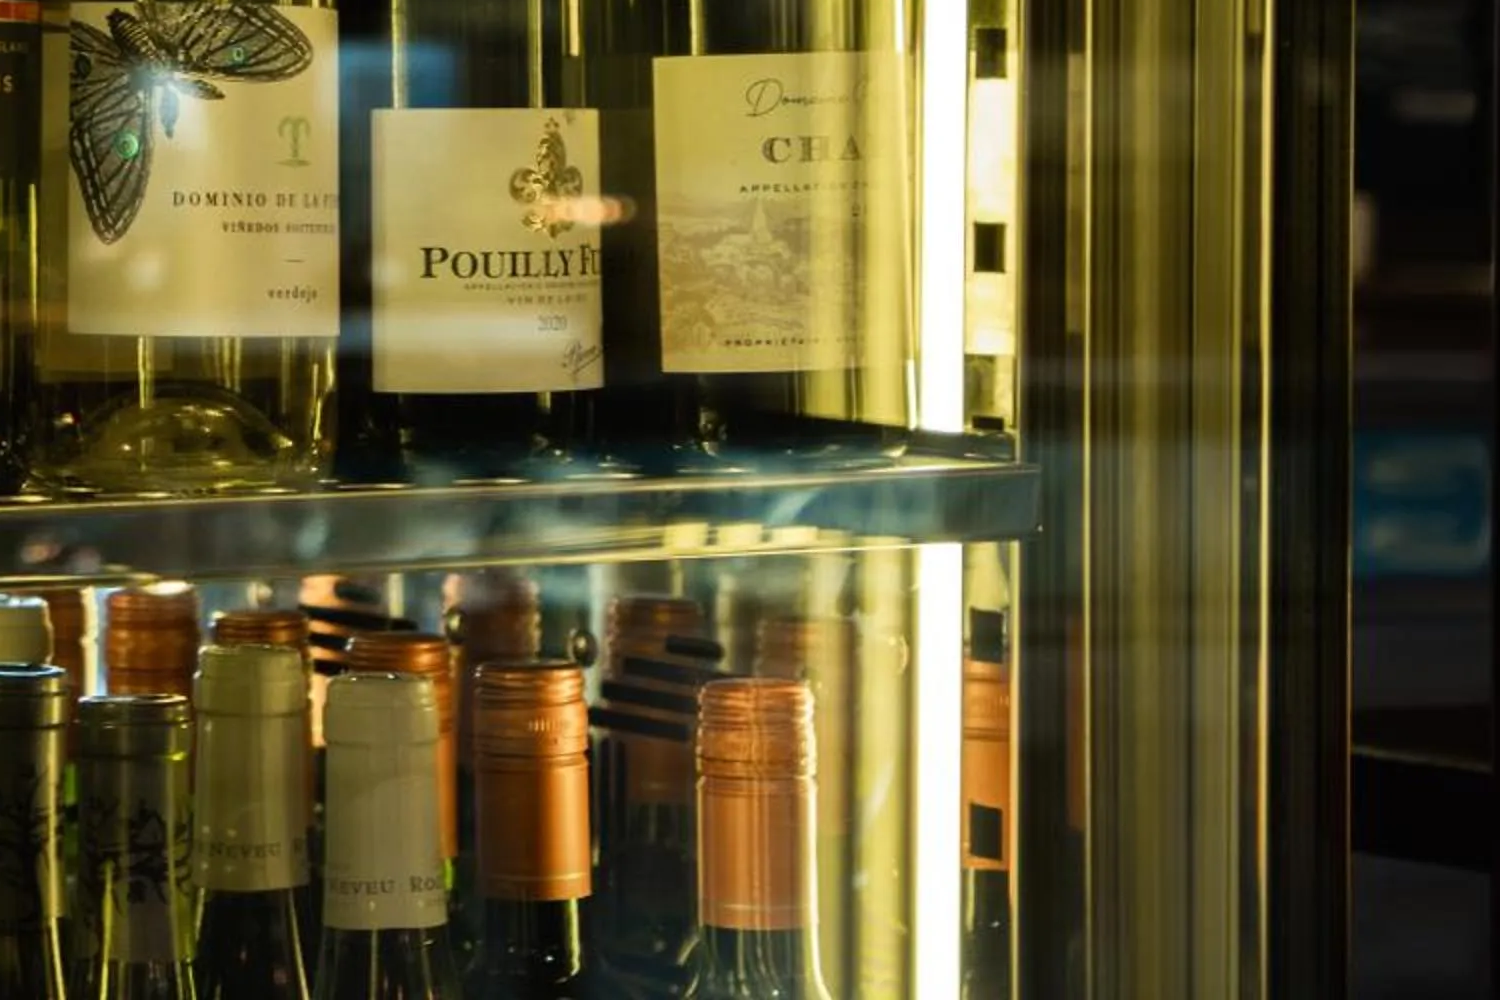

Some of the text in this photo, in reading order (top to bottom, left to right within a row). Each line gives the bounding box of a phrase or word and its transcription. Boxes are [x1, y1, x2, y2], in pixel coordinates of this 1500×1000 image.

[173, 191, 267, 207] DOMINIO
[420, 247, 573, 278] POUILLY
[267, 286, 317, 303] verdejo
